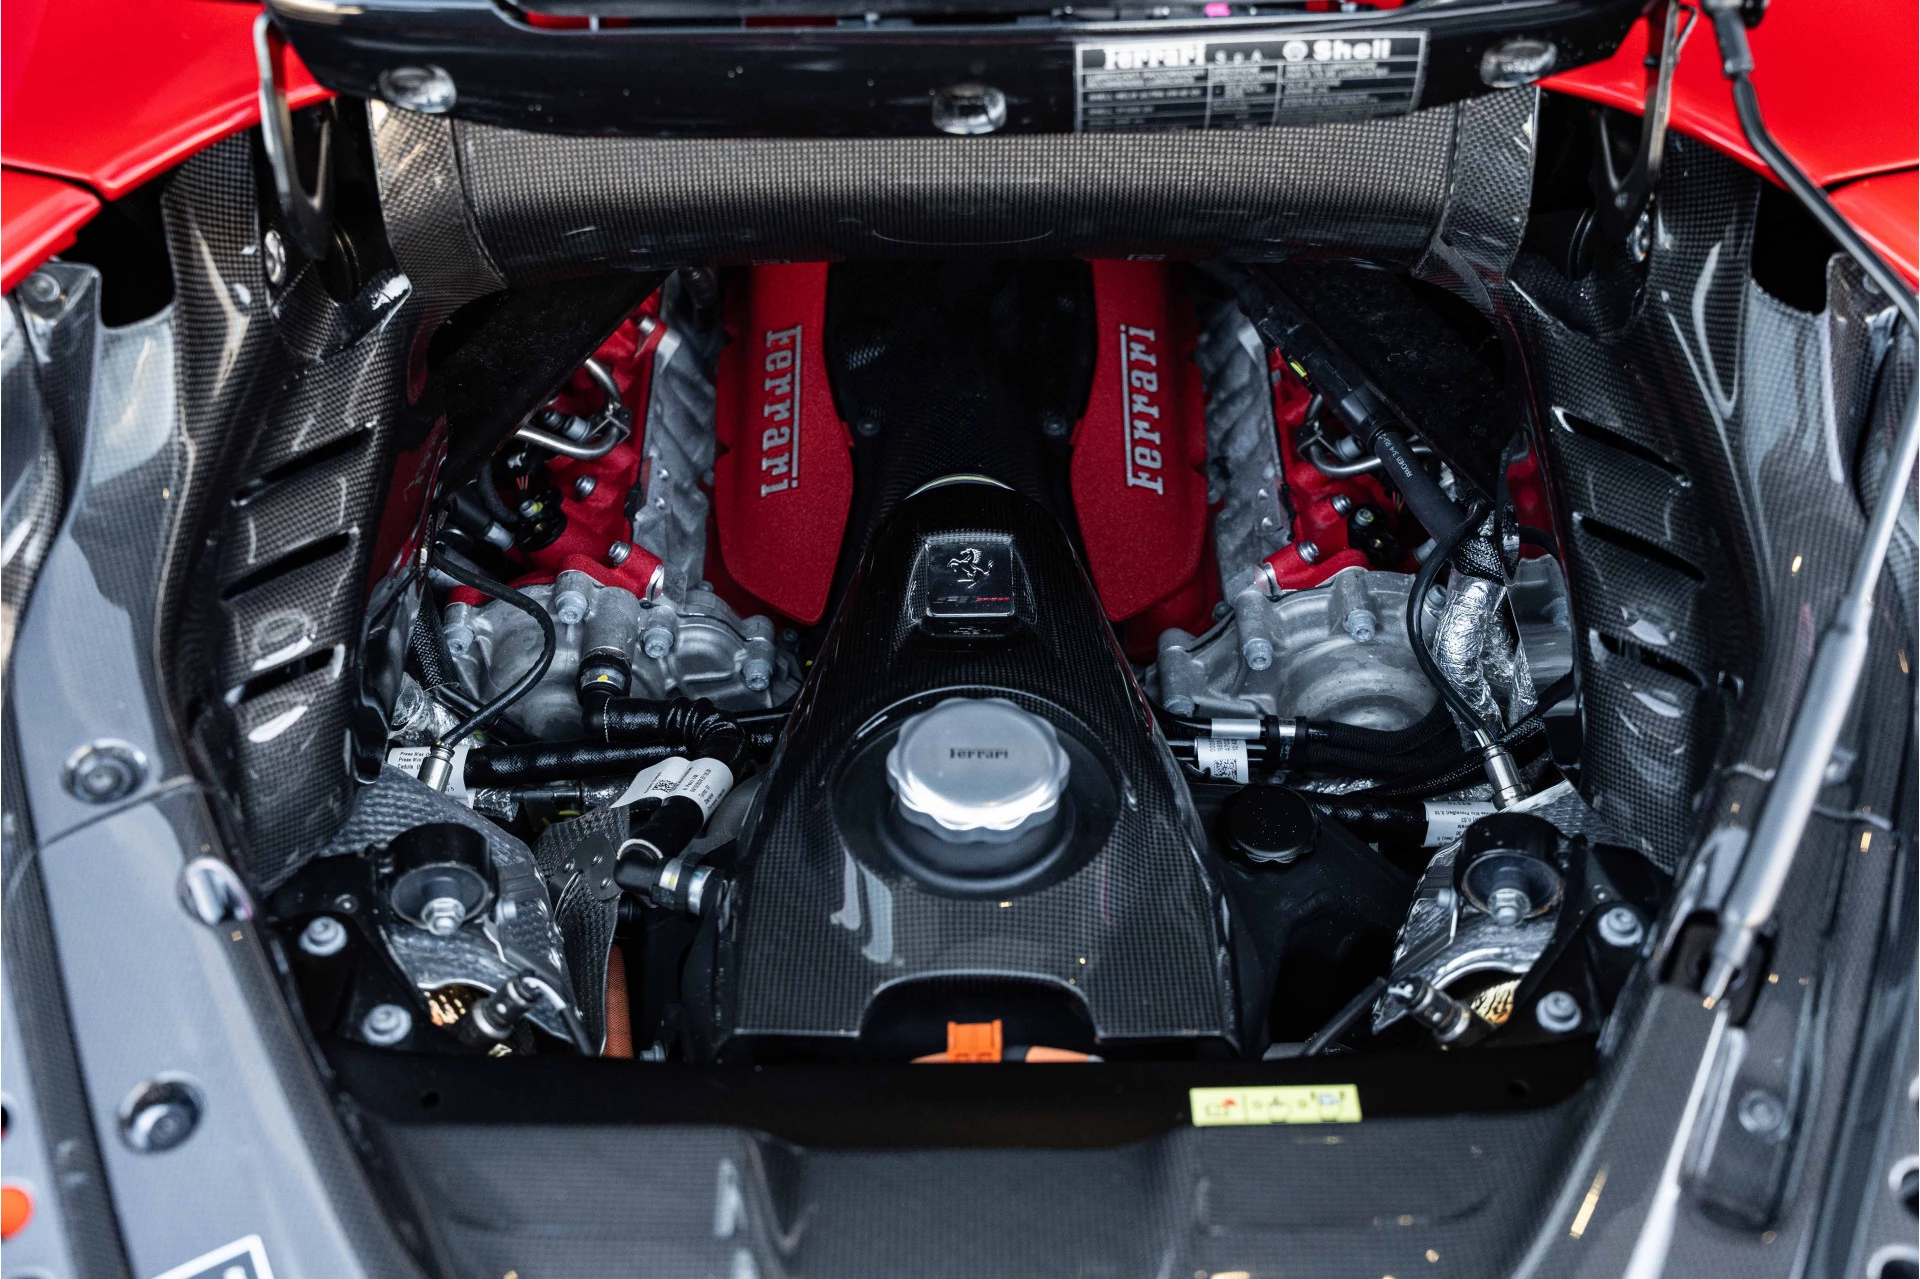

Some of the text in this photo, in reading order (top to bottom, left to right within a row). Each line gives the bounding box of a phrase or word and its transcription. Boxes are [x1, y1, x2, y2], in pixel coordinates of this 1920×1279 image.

[1103, 39, 1206, 69] Ferrari
[1312, 39, 1392, 61] Shell
[760, 325, 802, 497] Ferrari
[1119, 324, 1163, 495] Ferrari
